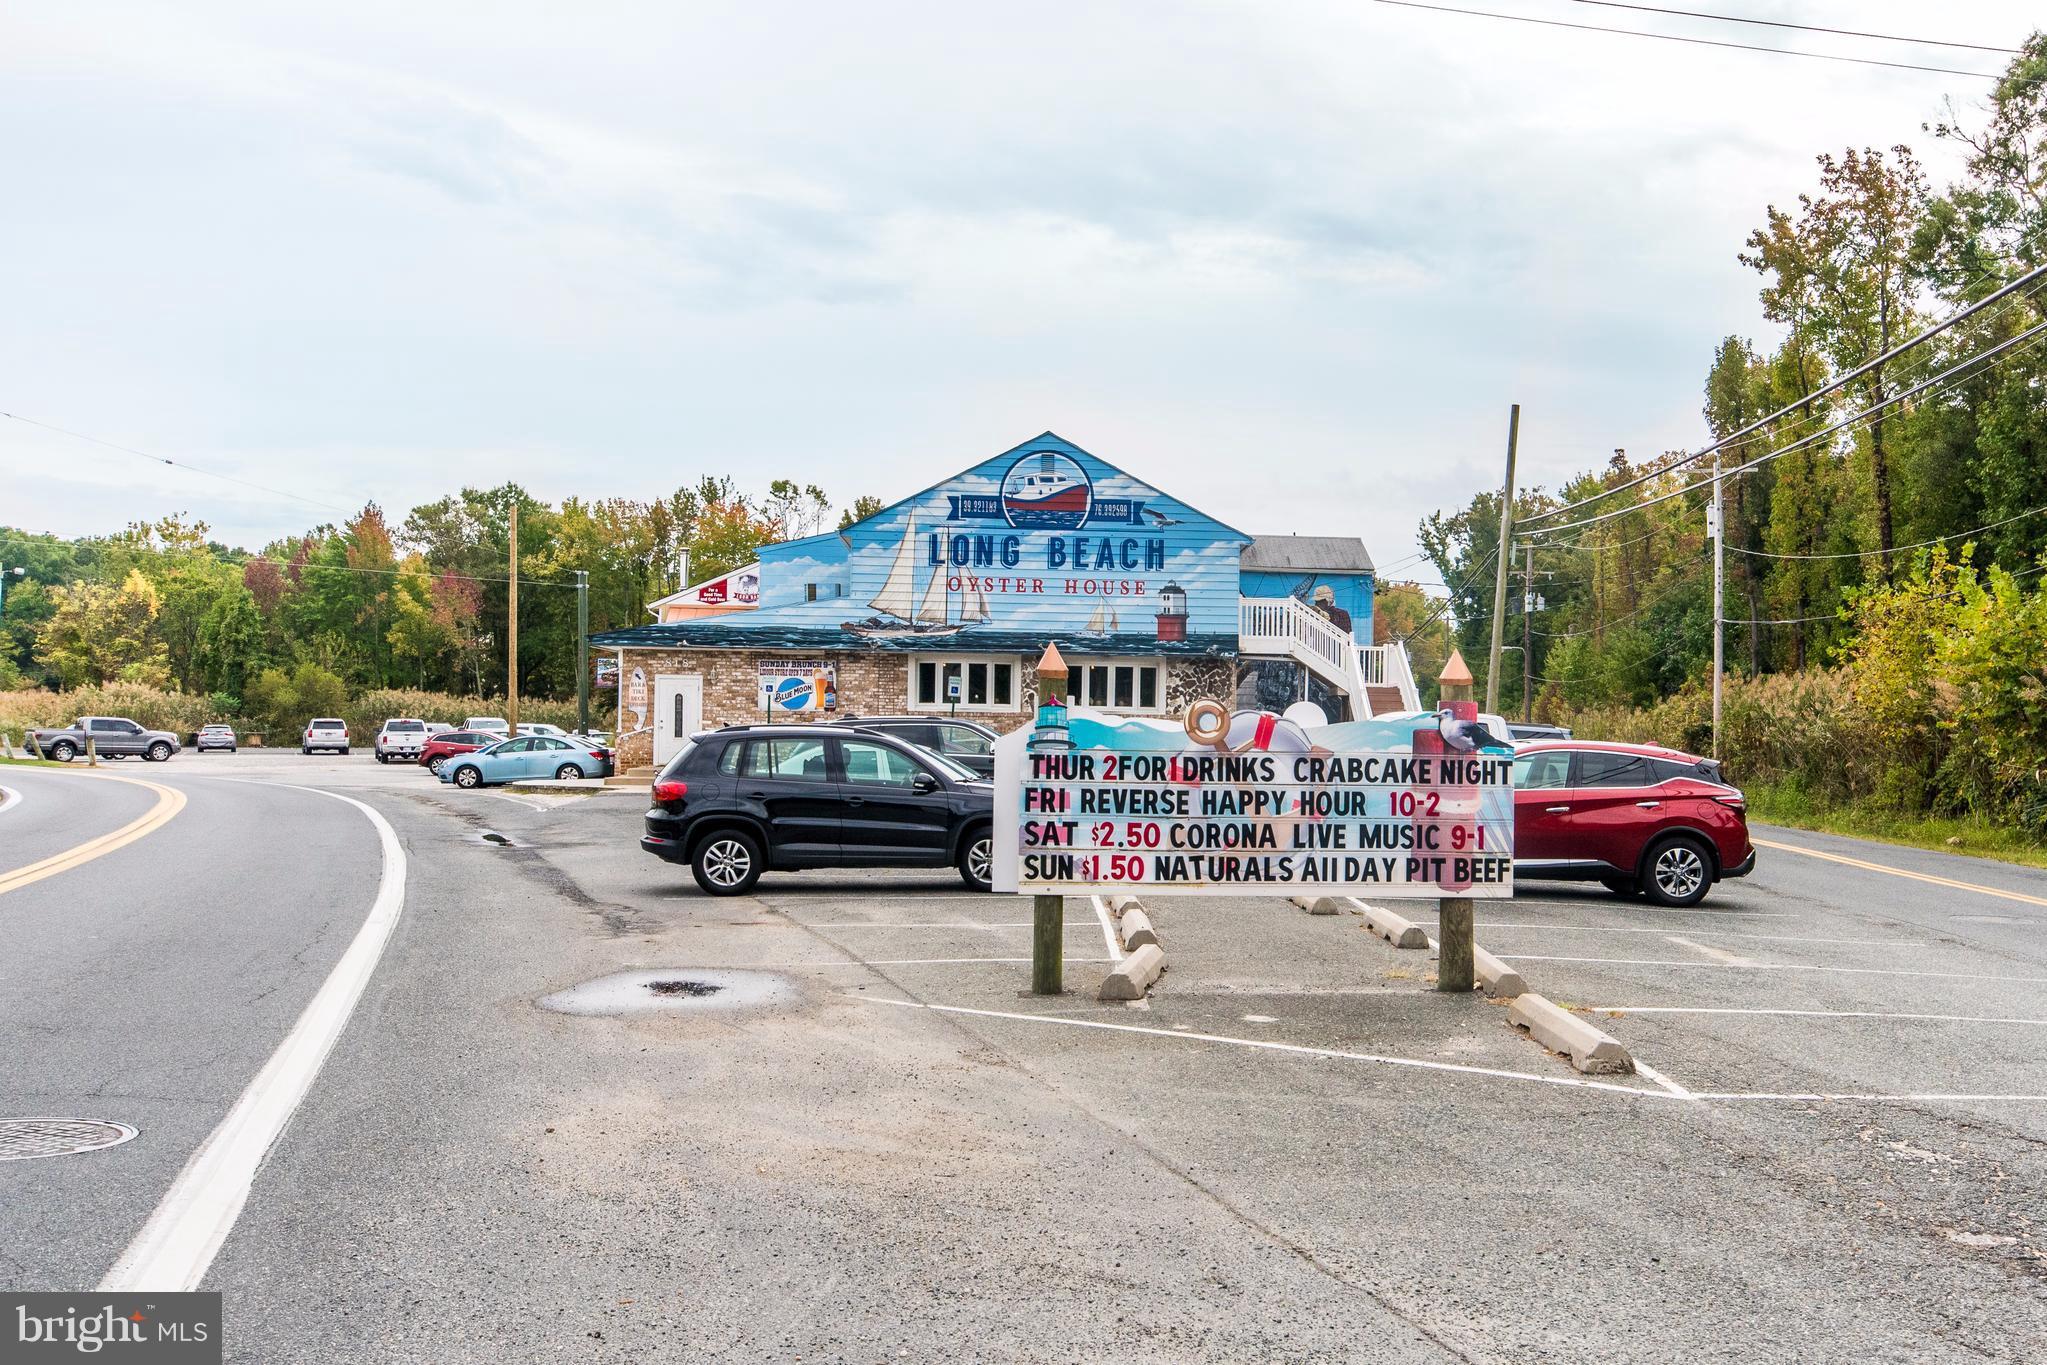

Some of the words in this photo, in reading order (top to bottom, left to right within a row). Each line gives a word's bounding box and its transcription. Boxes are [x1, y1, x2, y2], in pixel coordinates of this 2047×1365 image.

[929, 534, 1020, 568] LONG
[1048, 537, 1164, 571] BEACH
[947, 576, 1044, 594] OYSTER
[1065, 579, 1146, 595] HOUSE
[665, 659, 689, 667] 818
[760, 660, 790, 668] SUNDAY
[760, 668, 774, 676] LIQUOR
[774, 691, 793, 702] BLUE
[793, 684, 812, 696] MOON
[1029, 754, 1095, 781] THUR
[1183, 756, 1275, 783] DRINKS
[1294, 757, 1432, 784] CRABCAKE
[1440, 759, 1513, 785] NIGHT
[1024, 787, 1065, 813] FRI
[1080, 788, 1190, 815] REVERSE
[1202, 790, 1286, 816] HAPPY
[1300, 791, 1367, 817] HOUR
[1390, 791, 1441, 817] 10-2
[1024, 820, 1078, 847] SAT
[1091, 821, 1161, 848] $2.50
[1170, 823, 1277, 849] CORONA
[1293, 823, 1346, 849] LIVE
[1359, 824, 1440, 850] MUSIC
[1451, 824, 1485, 850] 9-1
[1024, 854, 1073, 880] SUN
[1082, 855, 1144, 881] $1.50
[1155, 855, 1294, 882] NATURALS
[1344, 857, 1397, 883] DAY
[1406, 857, 1447, 883] PIT
[1453, 857, 1511, 883] BEEF
